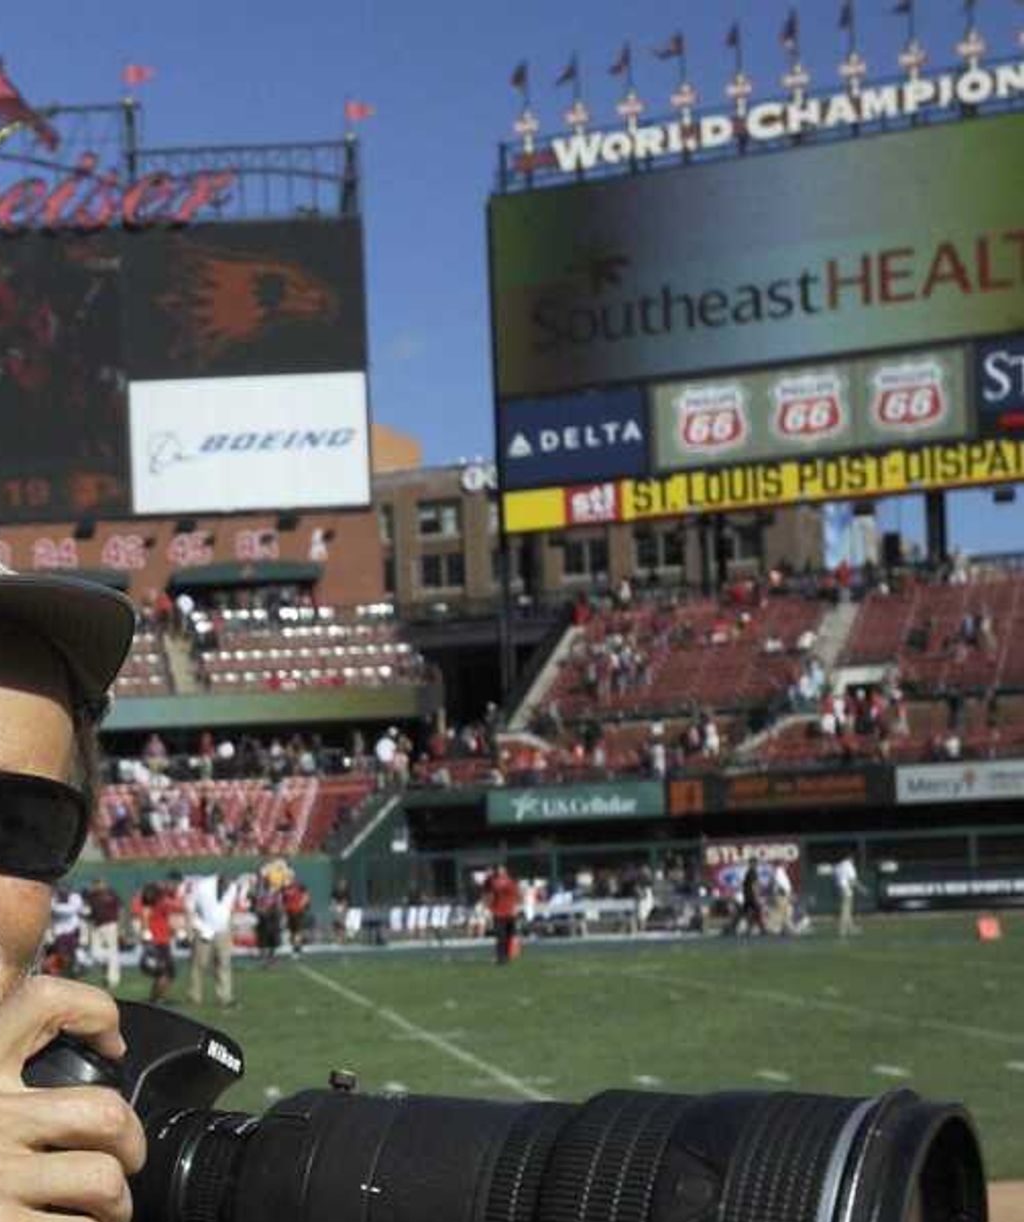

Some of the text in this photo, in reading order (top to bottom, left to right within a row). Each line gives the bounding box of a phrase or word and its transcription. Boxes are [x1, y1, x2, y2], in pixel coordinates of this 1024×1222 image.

[552, 114, 734, 173] WORLD
[783, 396, 832, 432] 66
[884, 388, 933, 422] 66
[200, 427, 355, 453] BOEING
[539, 418, 643, 453] DELTA
[688, 411, 738, 444] 66
[685, 464, 783, 506] LOUIS
[207, 1041, 242, 1073] Nikon
